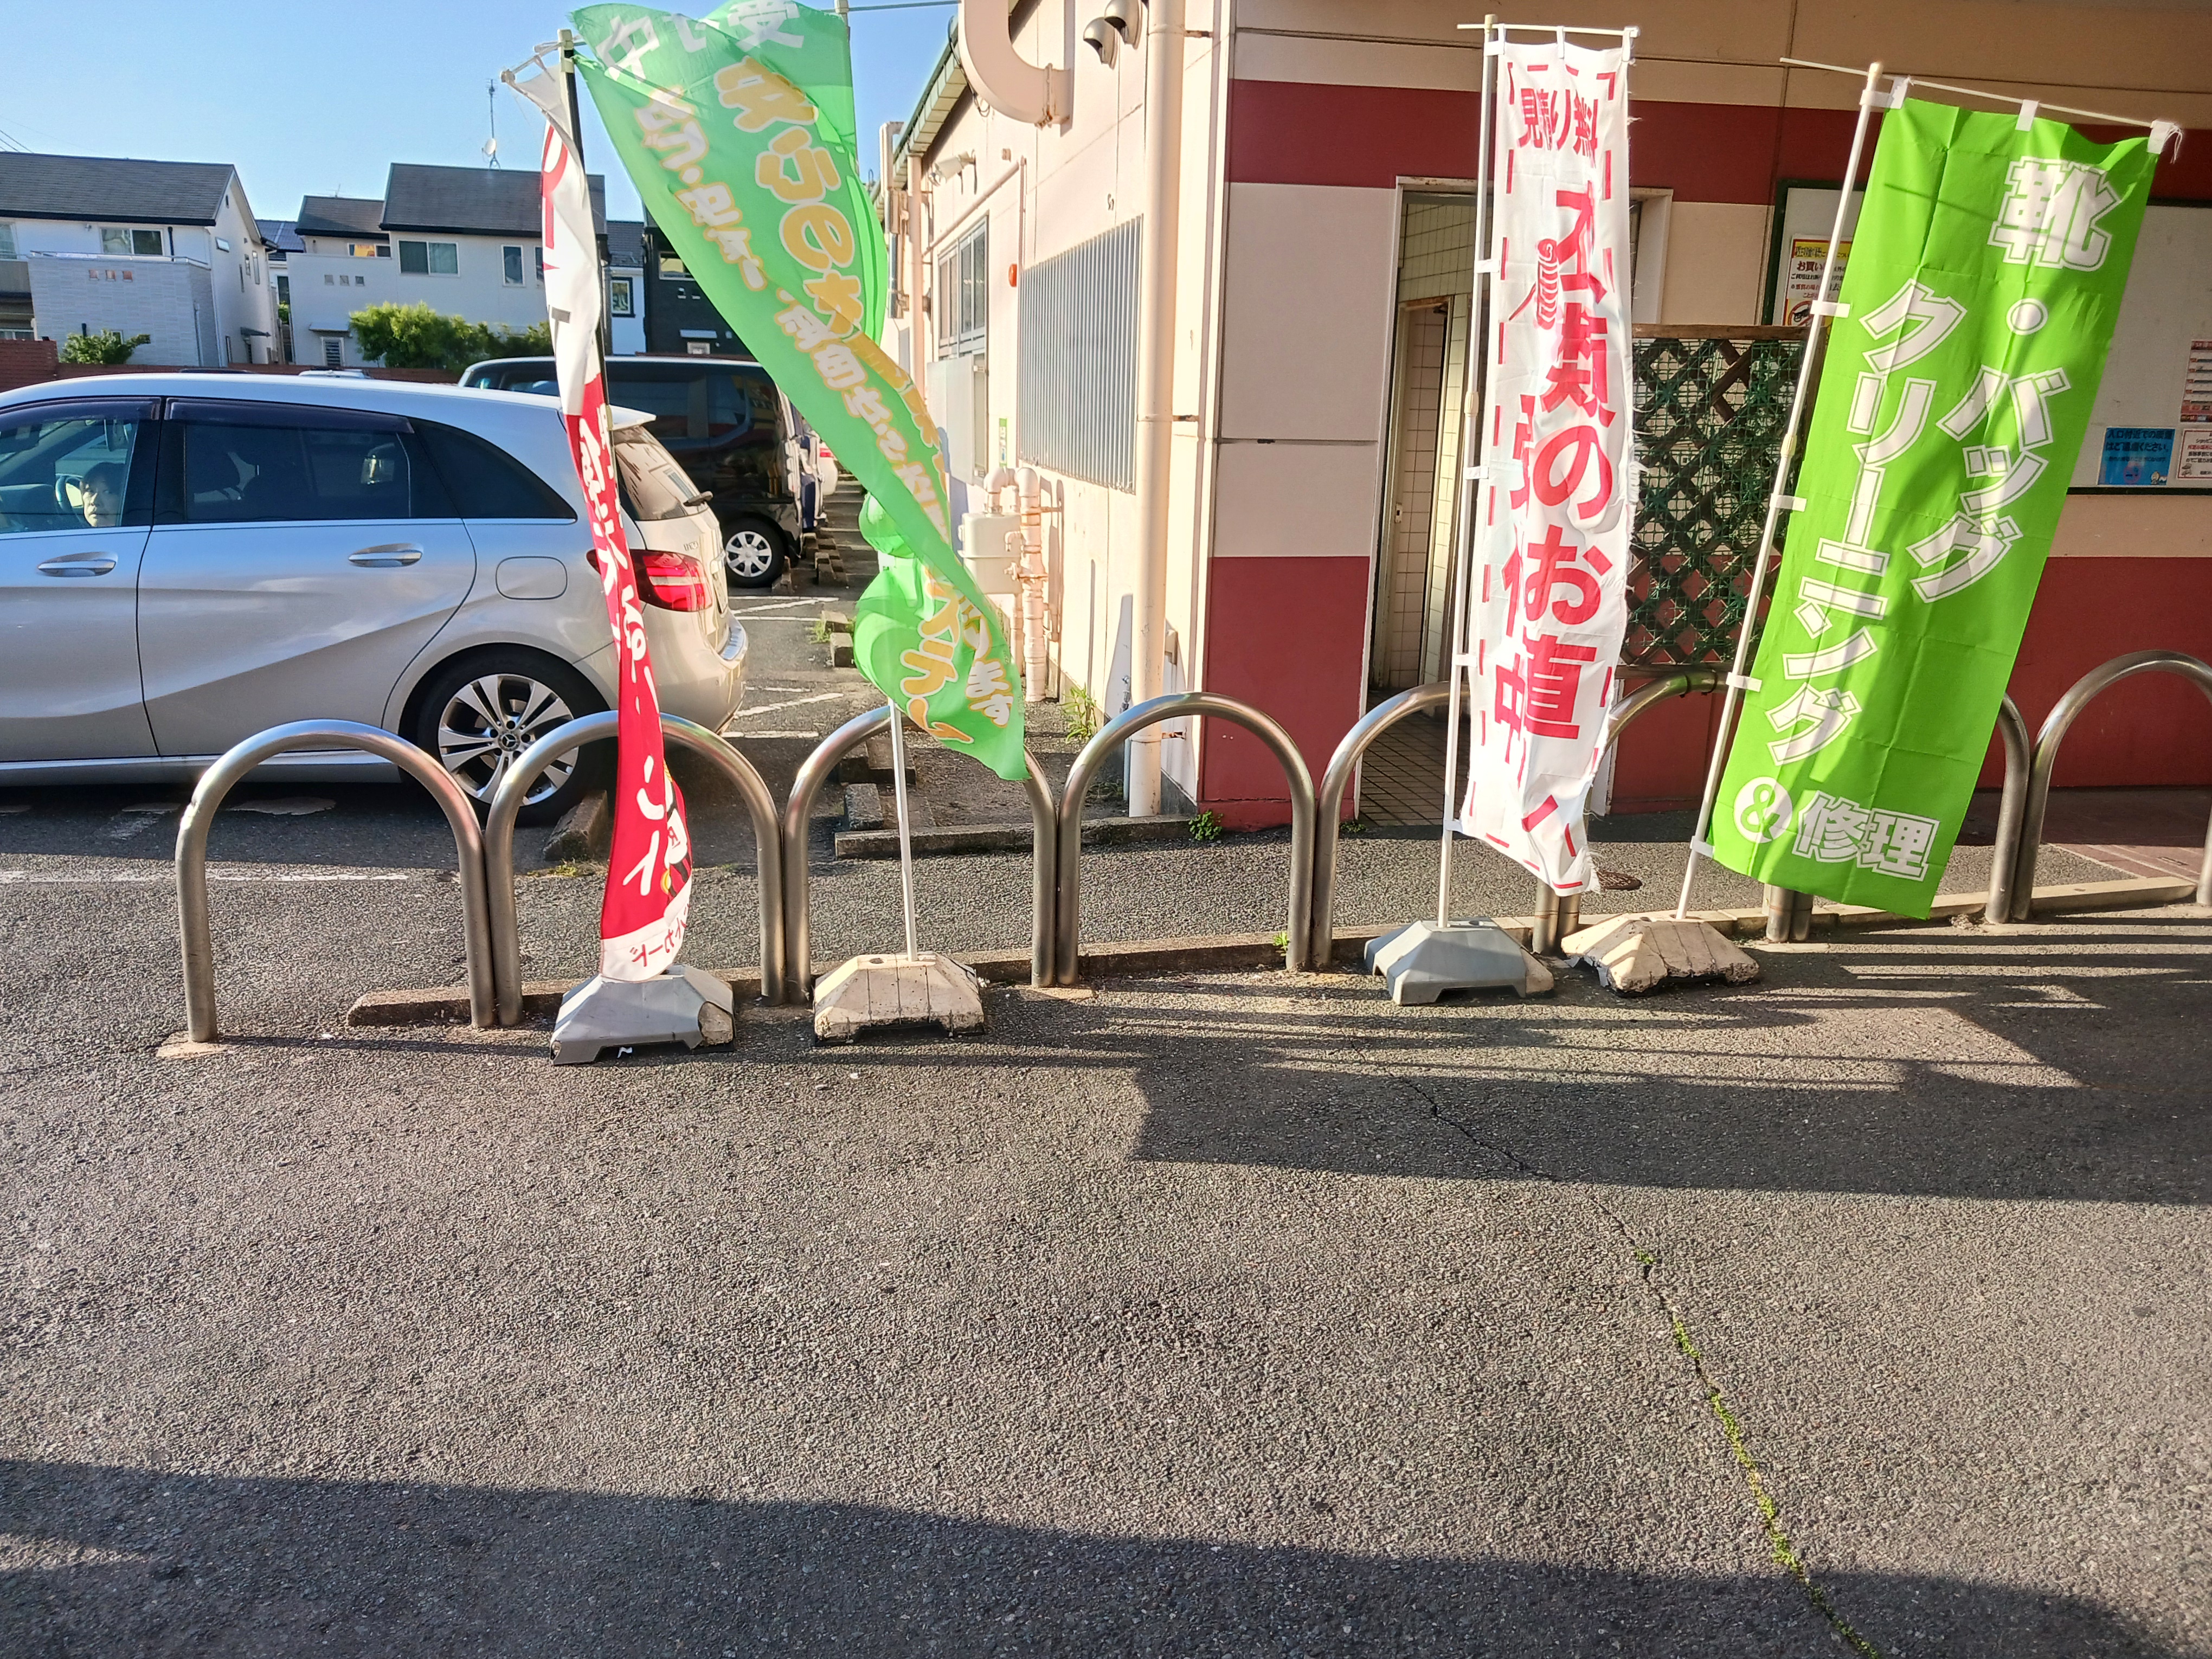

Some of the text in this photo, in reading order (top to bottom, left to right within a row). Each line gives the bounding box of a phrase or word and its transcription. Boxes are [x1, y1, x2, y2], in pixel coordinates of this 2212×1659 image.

[1765, 278, 1967, 766] クリーニング
